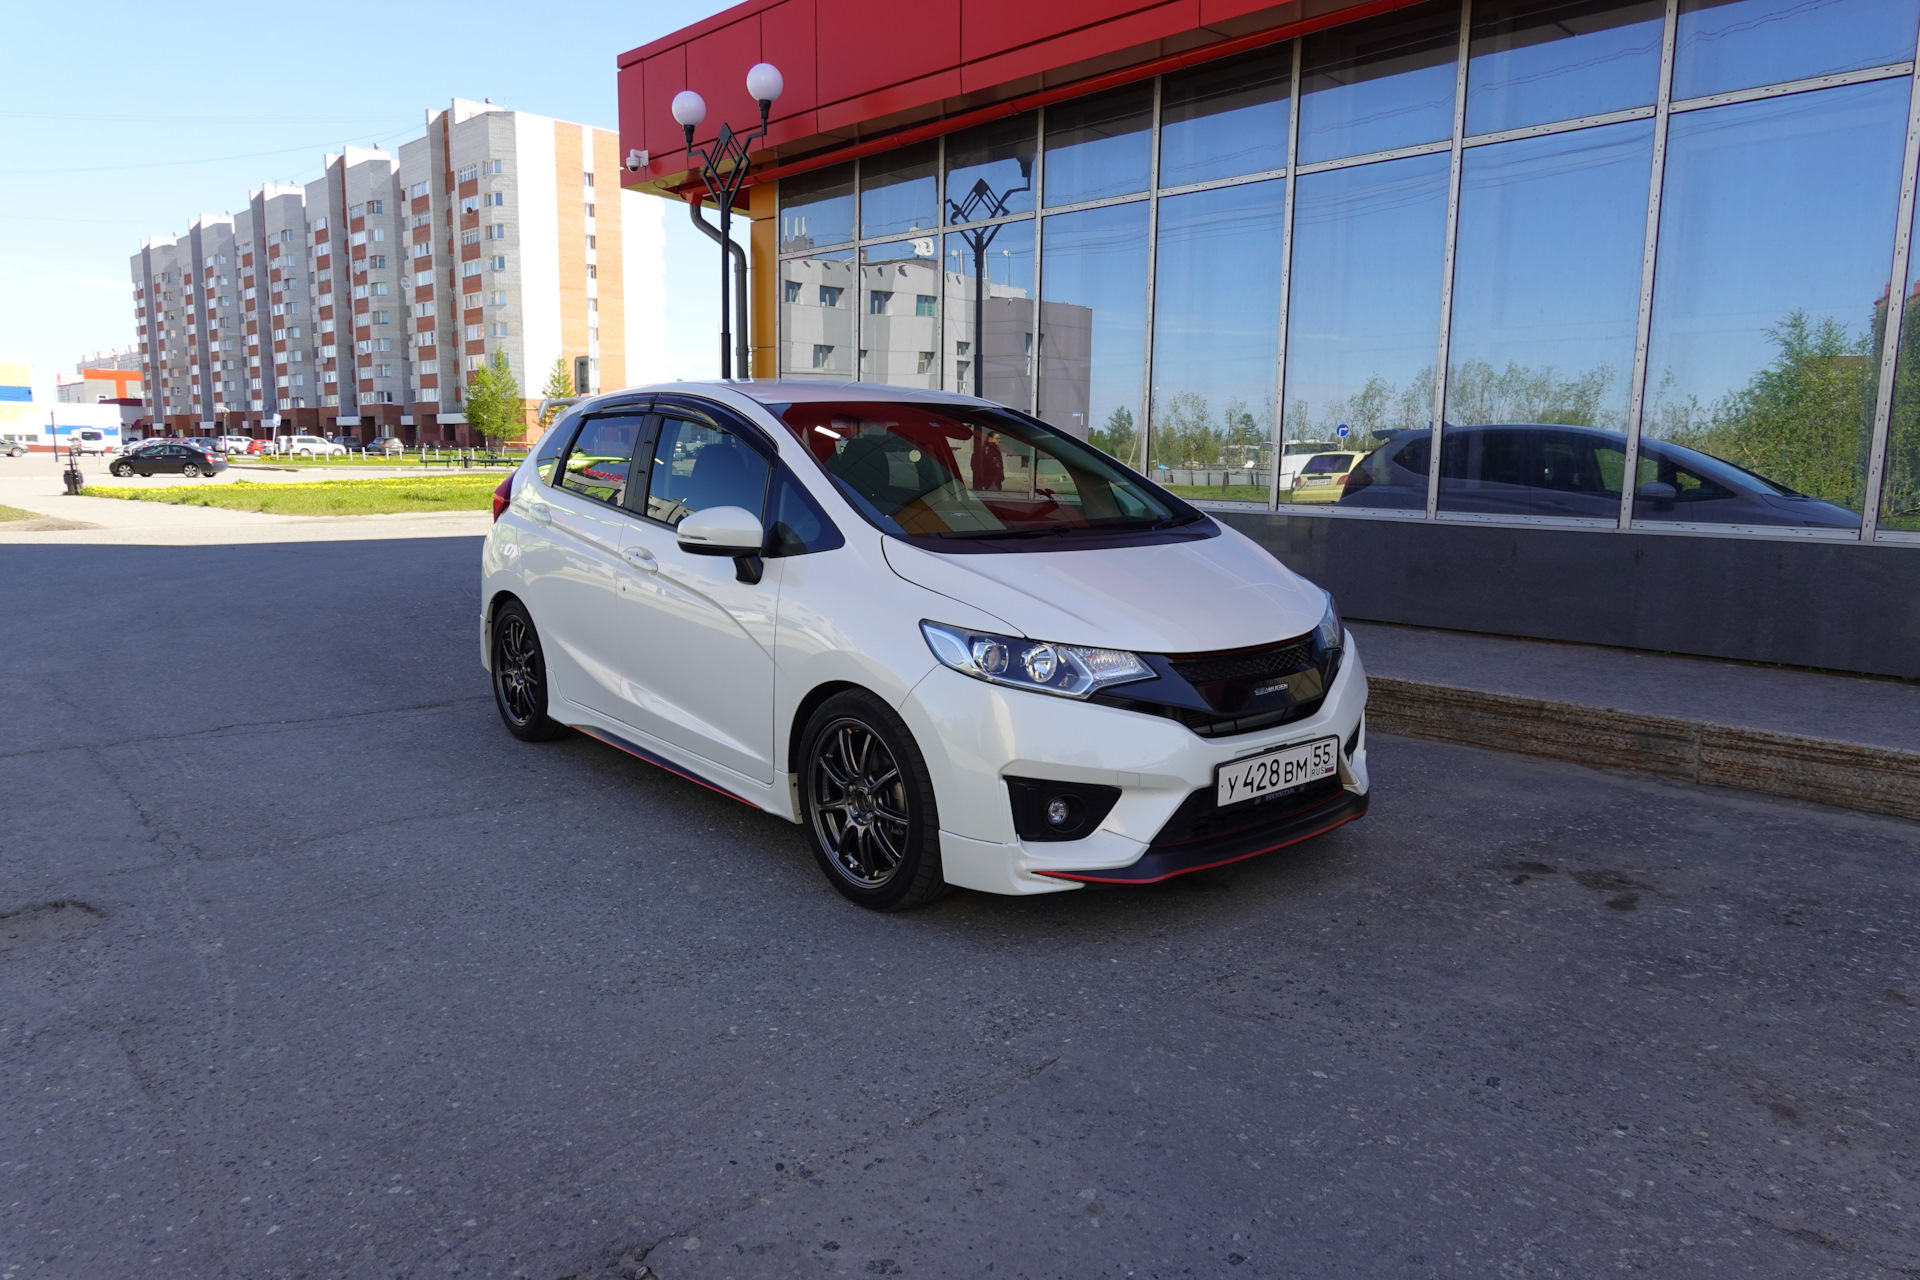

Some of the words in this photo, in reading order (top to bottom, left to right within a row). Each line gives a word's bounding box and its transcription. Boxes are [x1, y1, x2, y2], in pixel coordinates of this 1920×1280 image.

[1313, 743, 1331, 767] 55
[1311, 767, 1325, 777] RUS
[1265, 788, 1296, 801] HONDA
